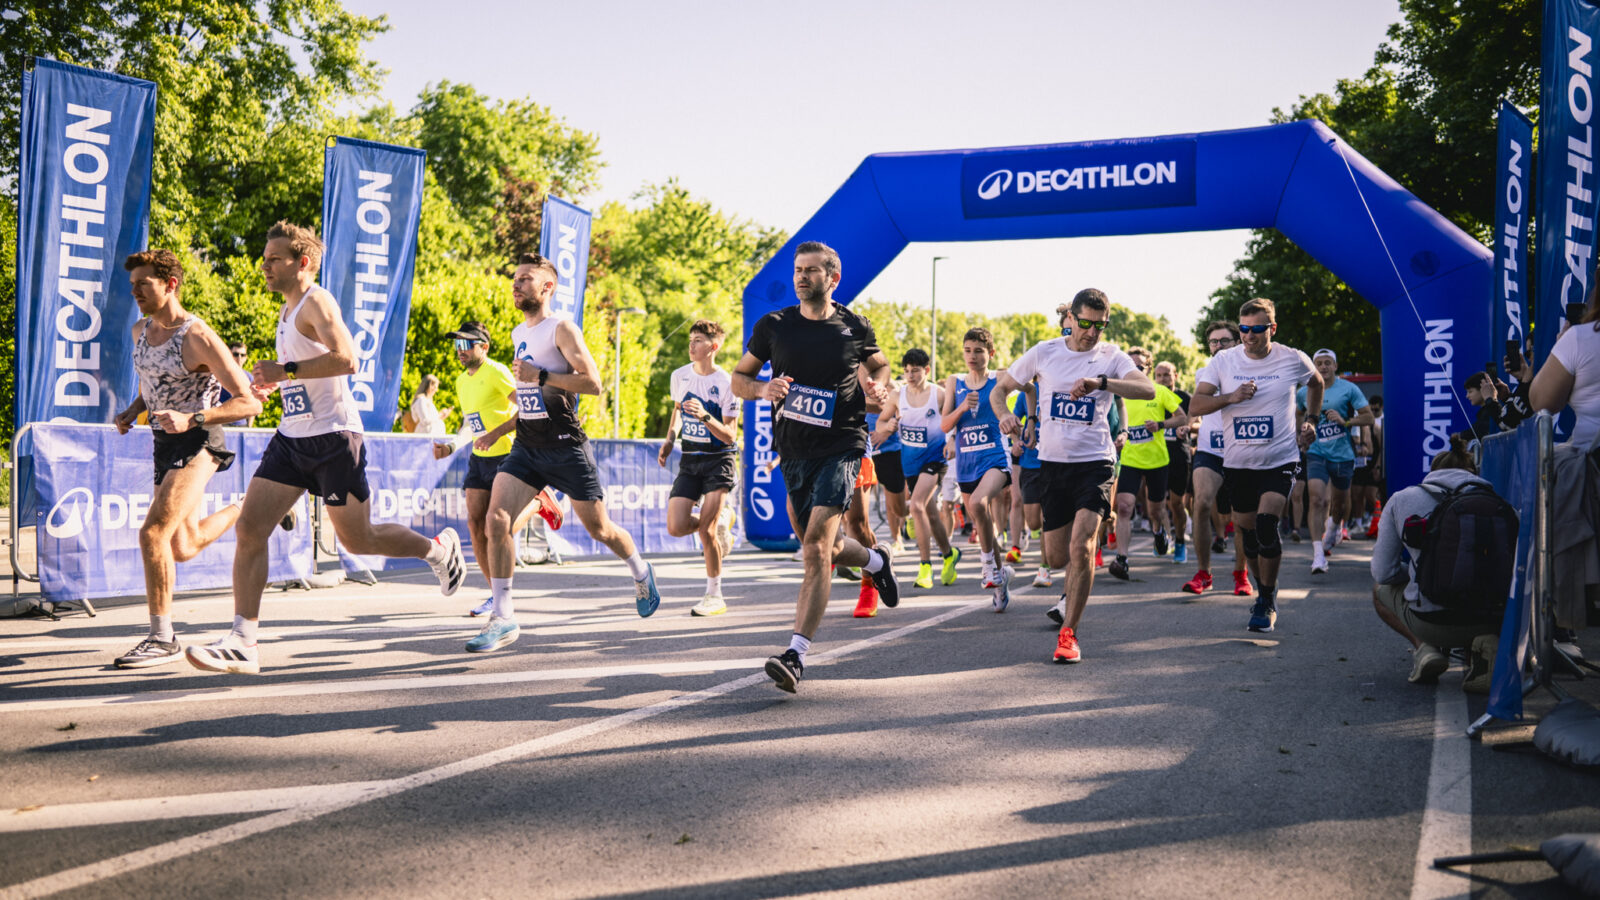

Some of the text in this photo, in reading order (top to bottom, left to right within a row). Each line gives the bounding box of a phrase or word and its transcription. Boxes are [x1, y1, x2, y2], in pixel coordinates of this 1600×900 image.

[1017, 161, 1176, 193] DECATHLON
[1559, 26, 1593, 332] CATHLON
[54, 102, 113, 406] DECATHLON
[351, 169, 392, 411] DECATHLON
[799, 386, 834, 398] DECATHLON
[791, 395, 827, 416] 410
[1056, 401, 1088, 418] 104
[684, 421, 707, 437] 395
[902, 430, 923, 442] 333
[1238, 423, 1269, 438] 409
[1320, 425, 1341, 437] 106
[962, 430, 988, 446] 196
